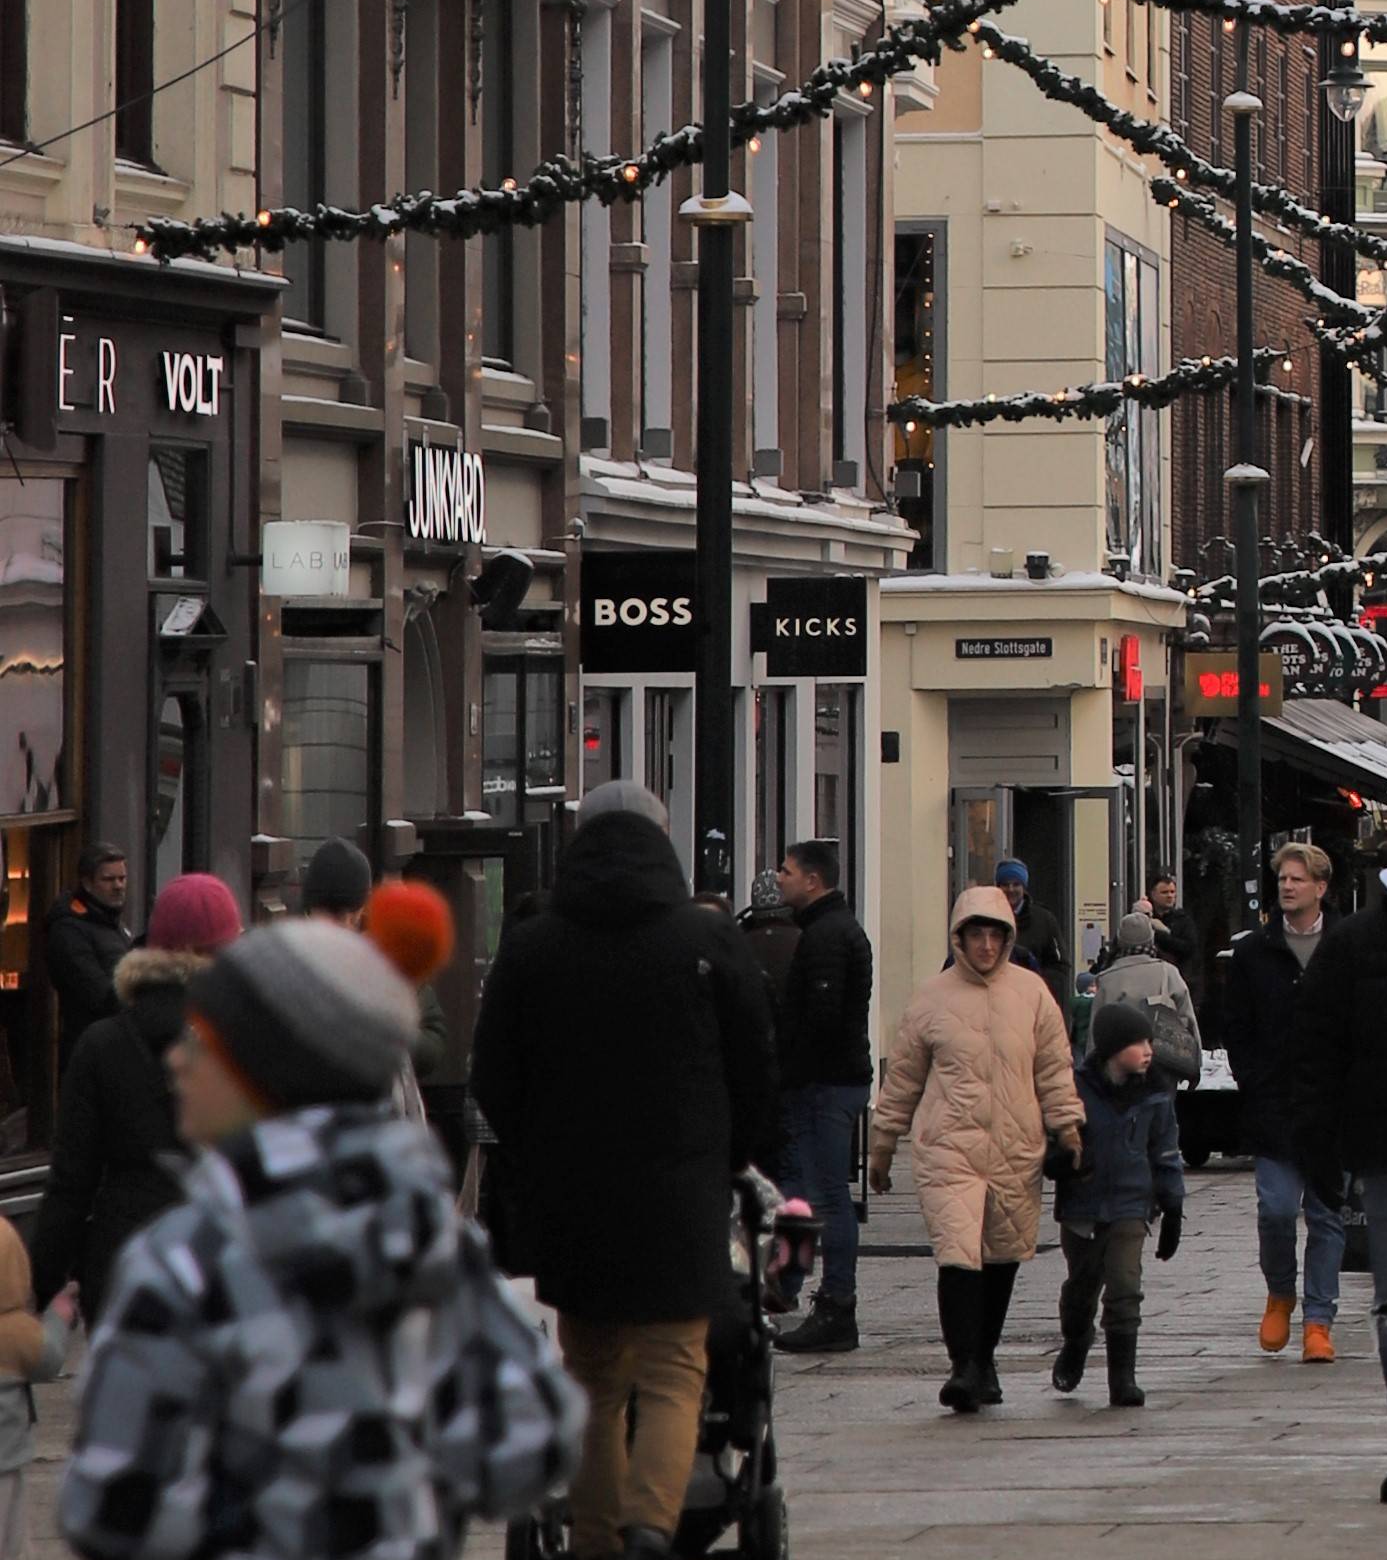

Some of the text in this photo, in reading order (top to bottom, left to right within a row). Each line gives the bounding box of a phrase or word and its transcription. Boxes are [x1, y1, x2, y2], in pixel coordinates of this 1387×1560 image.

[163, 351, 223, 416] VOLT
[272, 551, 324, 570] LAB
[594, 597, 693, 626] BOSS
[775, 617, 857, 637] KICKS
[962, 640, 1046, 657] Nedre Slottsgate
